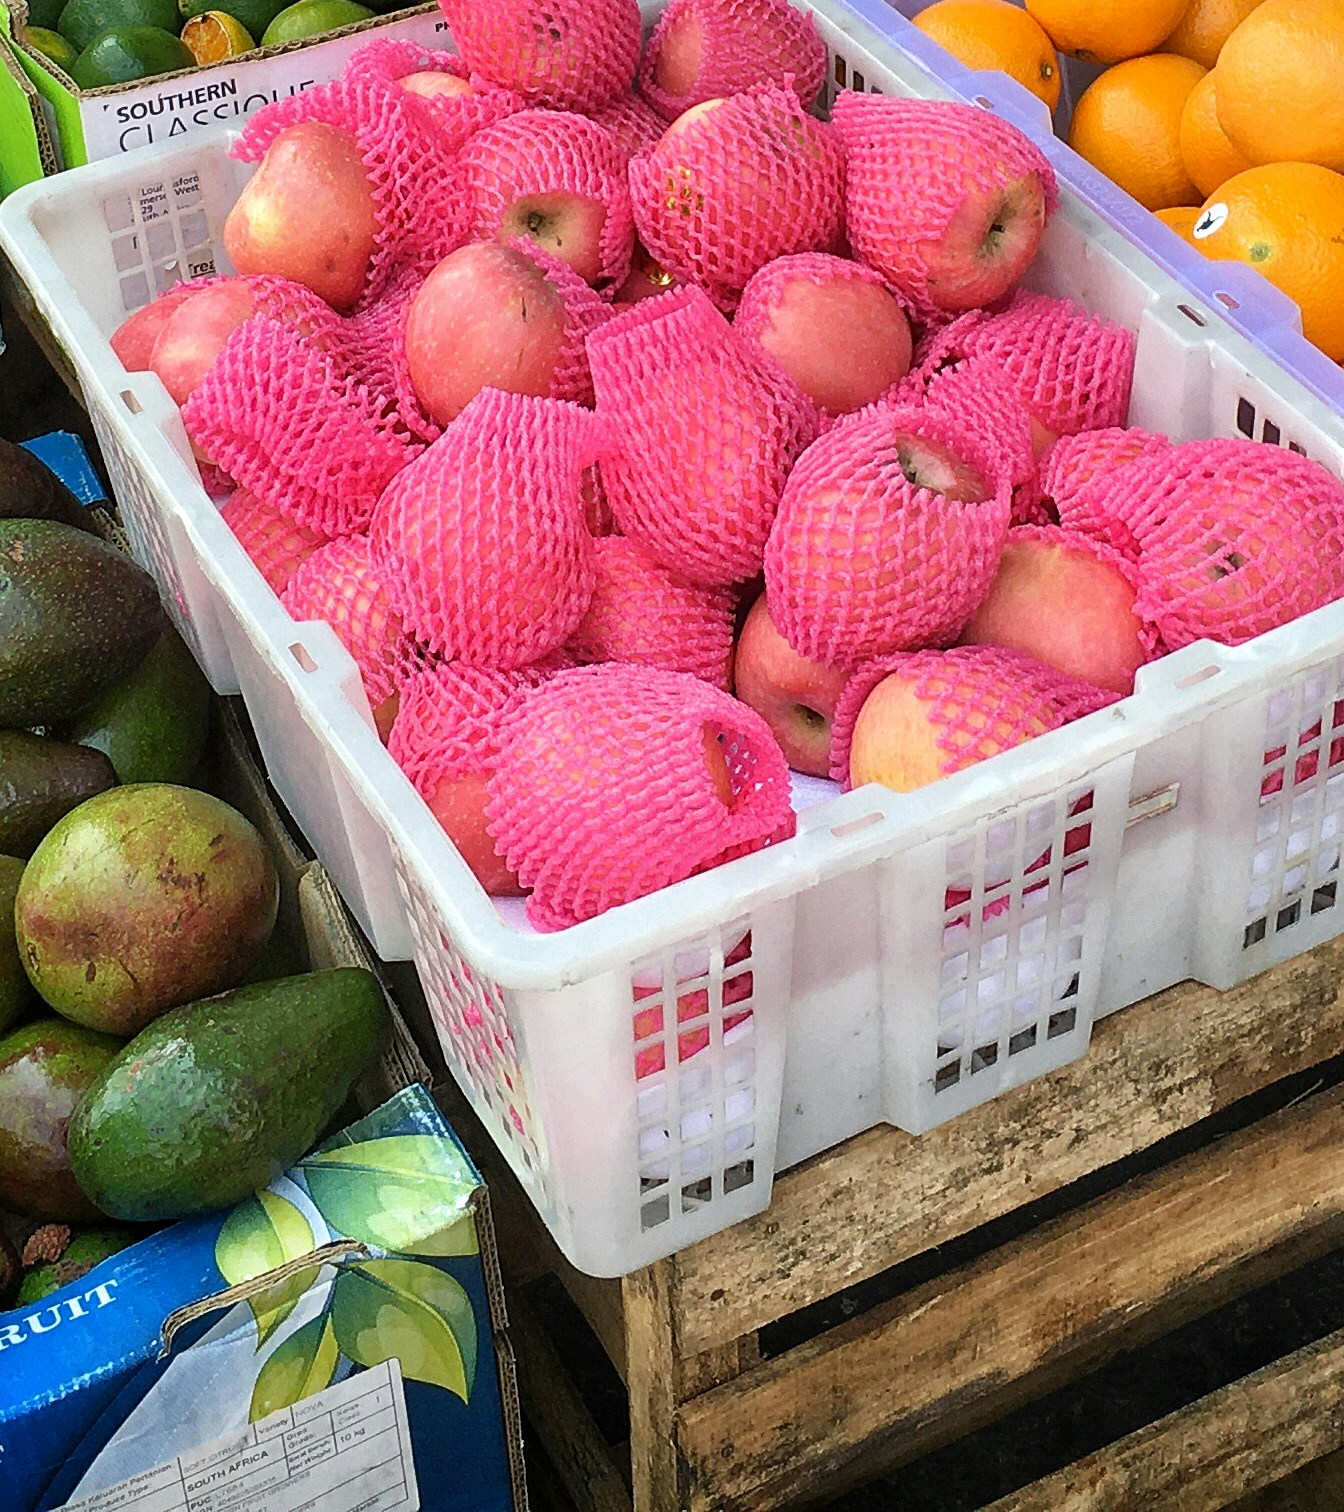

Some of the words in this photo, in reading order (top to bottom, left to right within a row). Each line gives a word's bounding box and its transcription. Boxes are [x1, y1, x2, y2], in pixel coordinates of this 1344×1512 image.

[116, 78, 238, 124] SOUTHERN
[174, 183, 200, 197] West
[295, 1400, 324, 1418] NOVA
[258, 1418, 289, 1435] Variety
[339, 1432, 353, 1443] 10
[353, 1427, 366, 1438] kg
[187, 1469, 226, 1492] SOUTH
[228, 1450, 270, 1474] AFRICA
[190, 1495, 212, 1511] PUC
